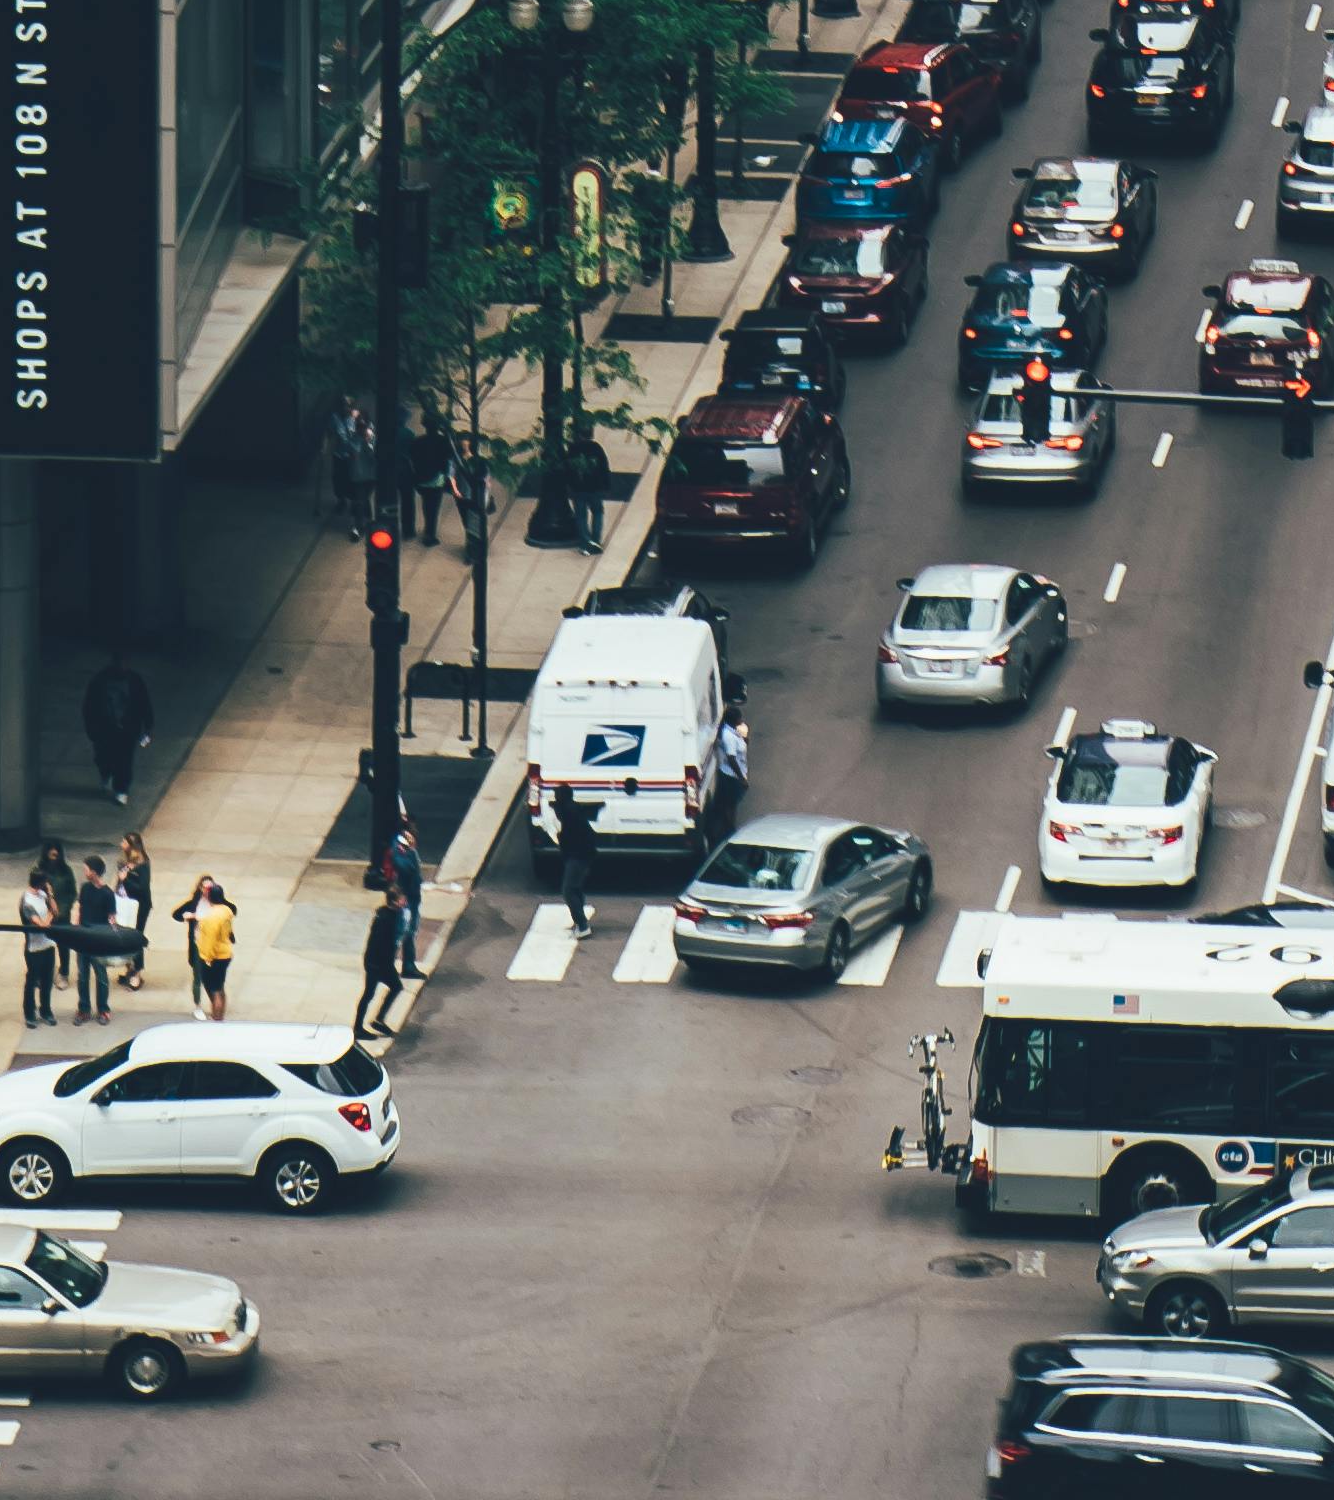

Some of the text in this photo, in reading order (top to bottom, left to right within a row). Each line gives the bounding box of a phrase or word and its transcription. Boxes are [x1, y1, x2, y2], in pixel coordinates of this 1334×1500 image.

[15, 64, 48, 86] N
[15, 104, 48, 178] 108
[16, 202, 48, 249] AT
[17, 272, 48, 410] SHOPS
[1221, 1150, 1244, 1162] cta
